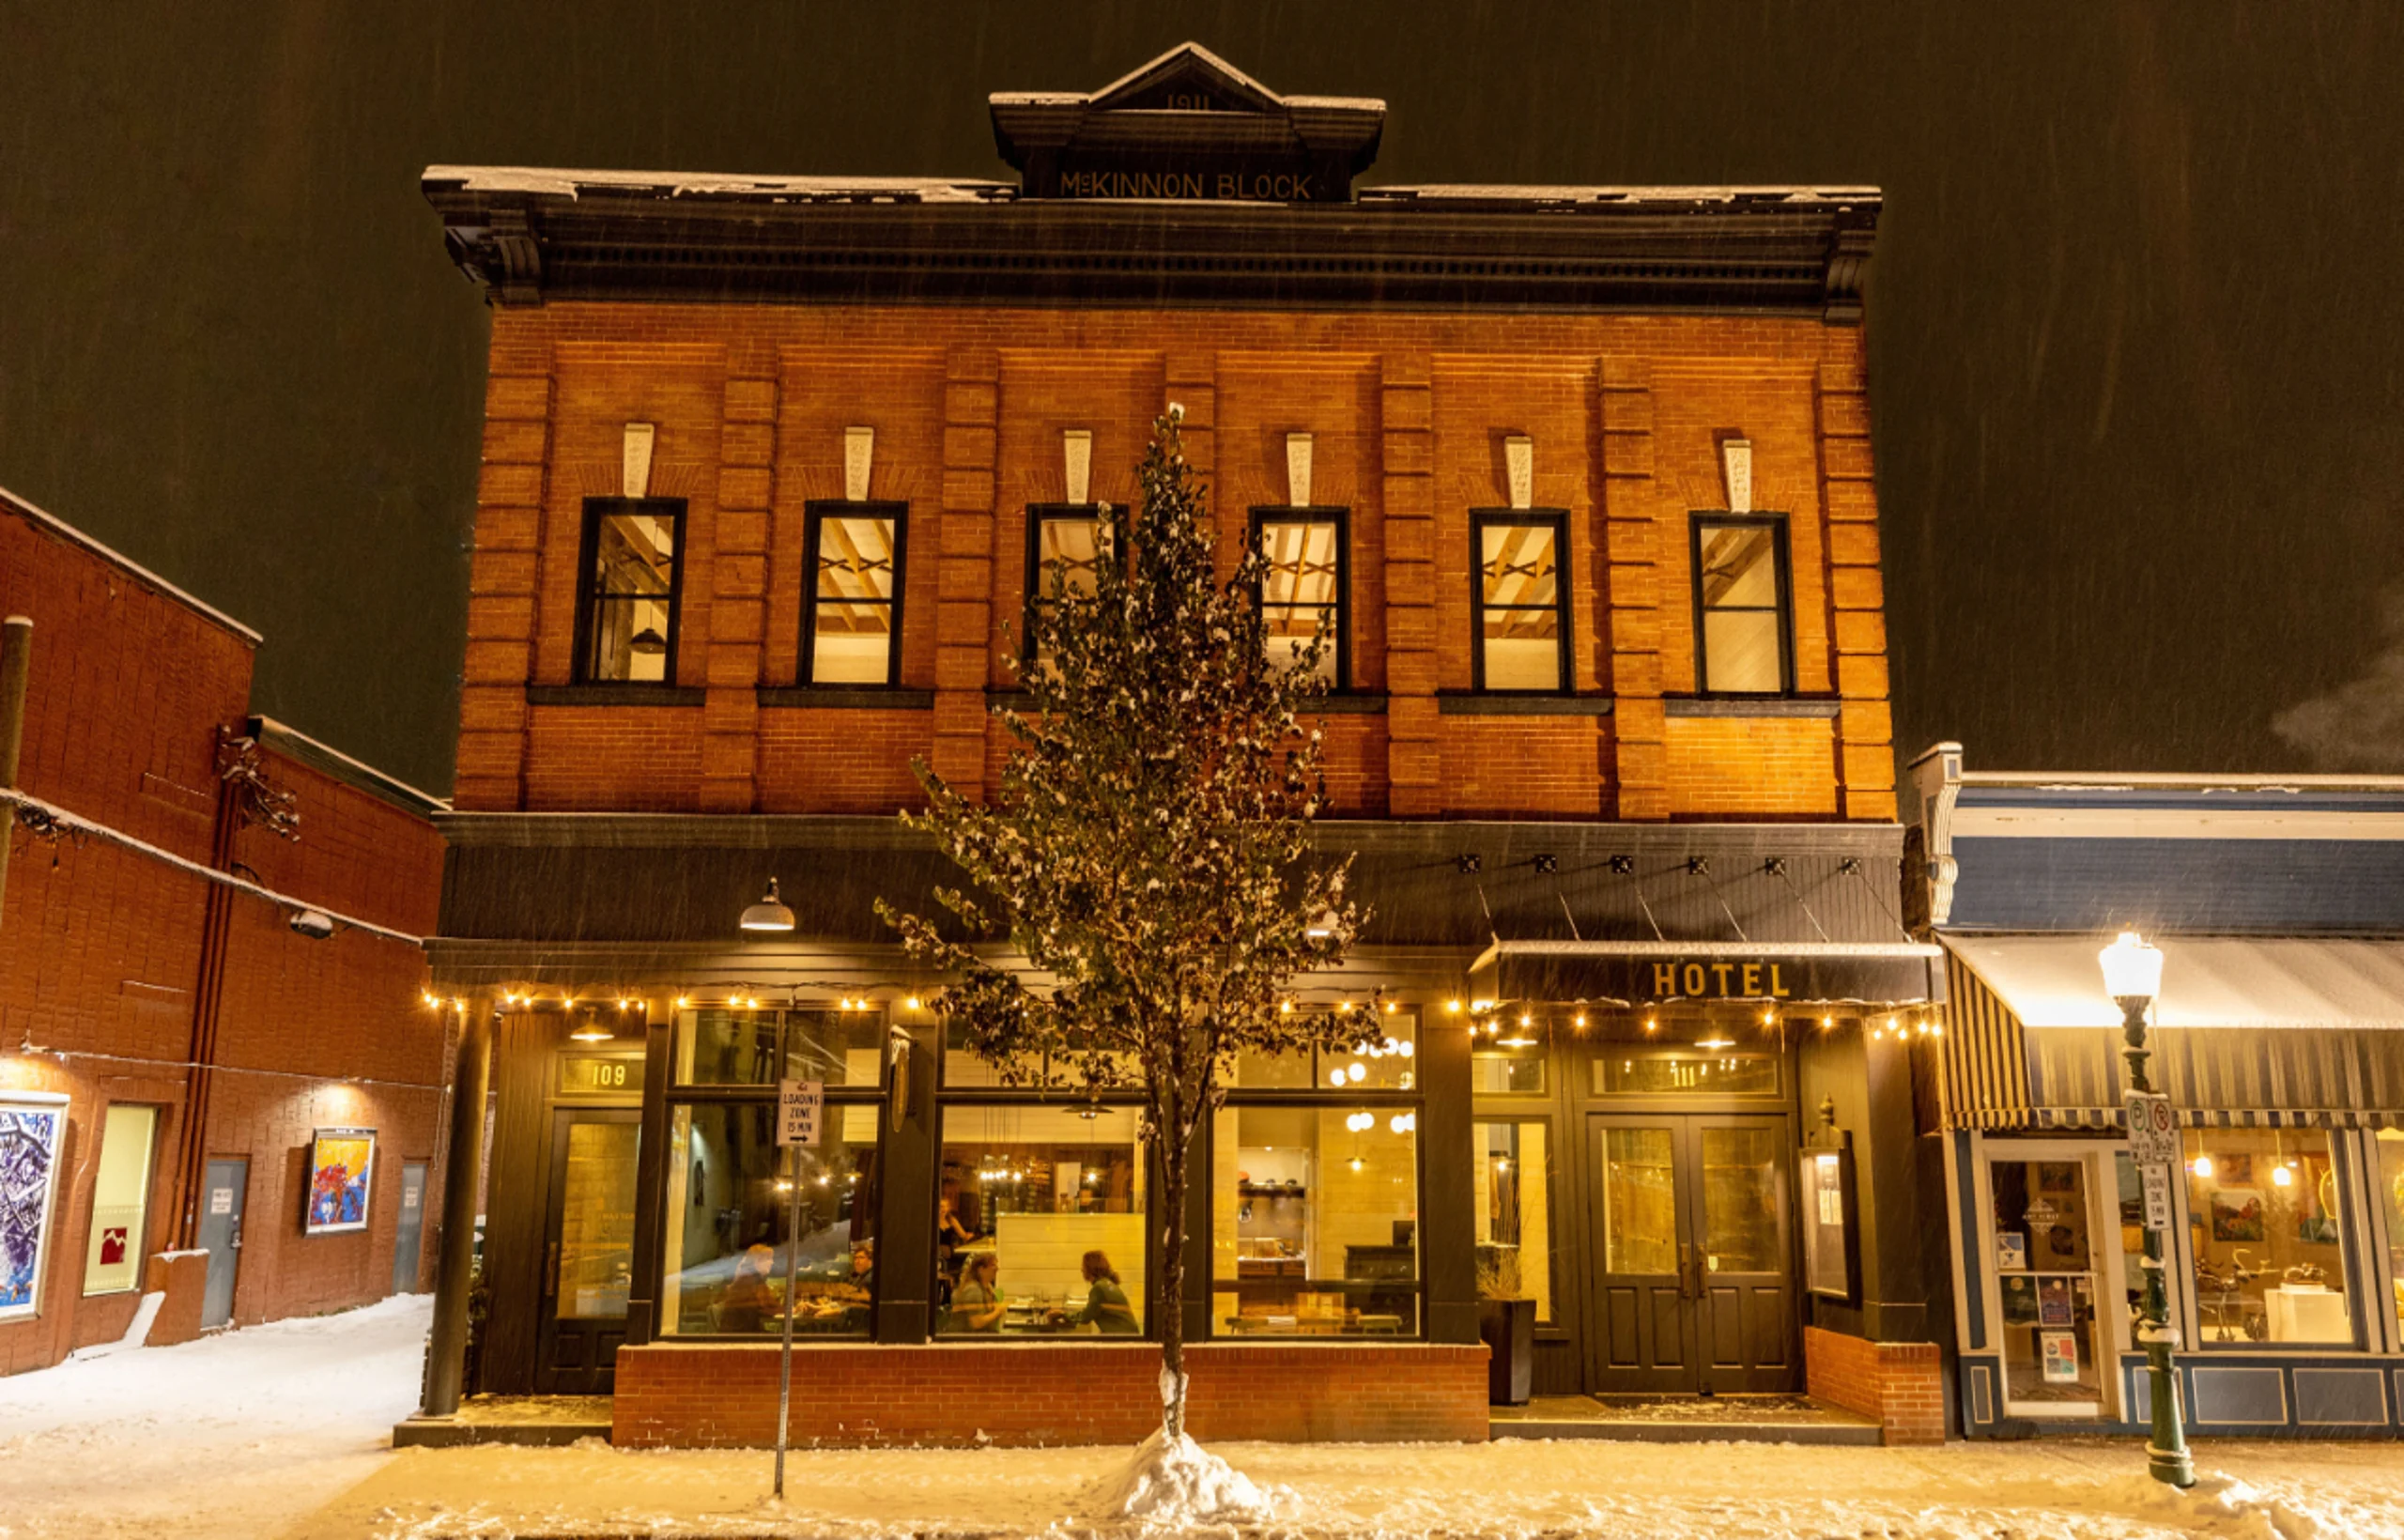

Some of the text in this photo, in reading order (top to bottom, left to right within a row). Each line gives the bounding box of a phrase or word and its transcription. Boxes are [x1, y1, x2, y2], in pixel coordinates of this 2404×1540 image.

[1218, 174, 1313, 200] BLOCK
[1653, 963, 1789, 996] HOTEL
[593, 1065, 625, 1086] 109
[1673, 1066, 1695, 1086] 111
[783, 1093, 819, 1105] LOADING
[790, 1107, 811, 1118] ZONE
